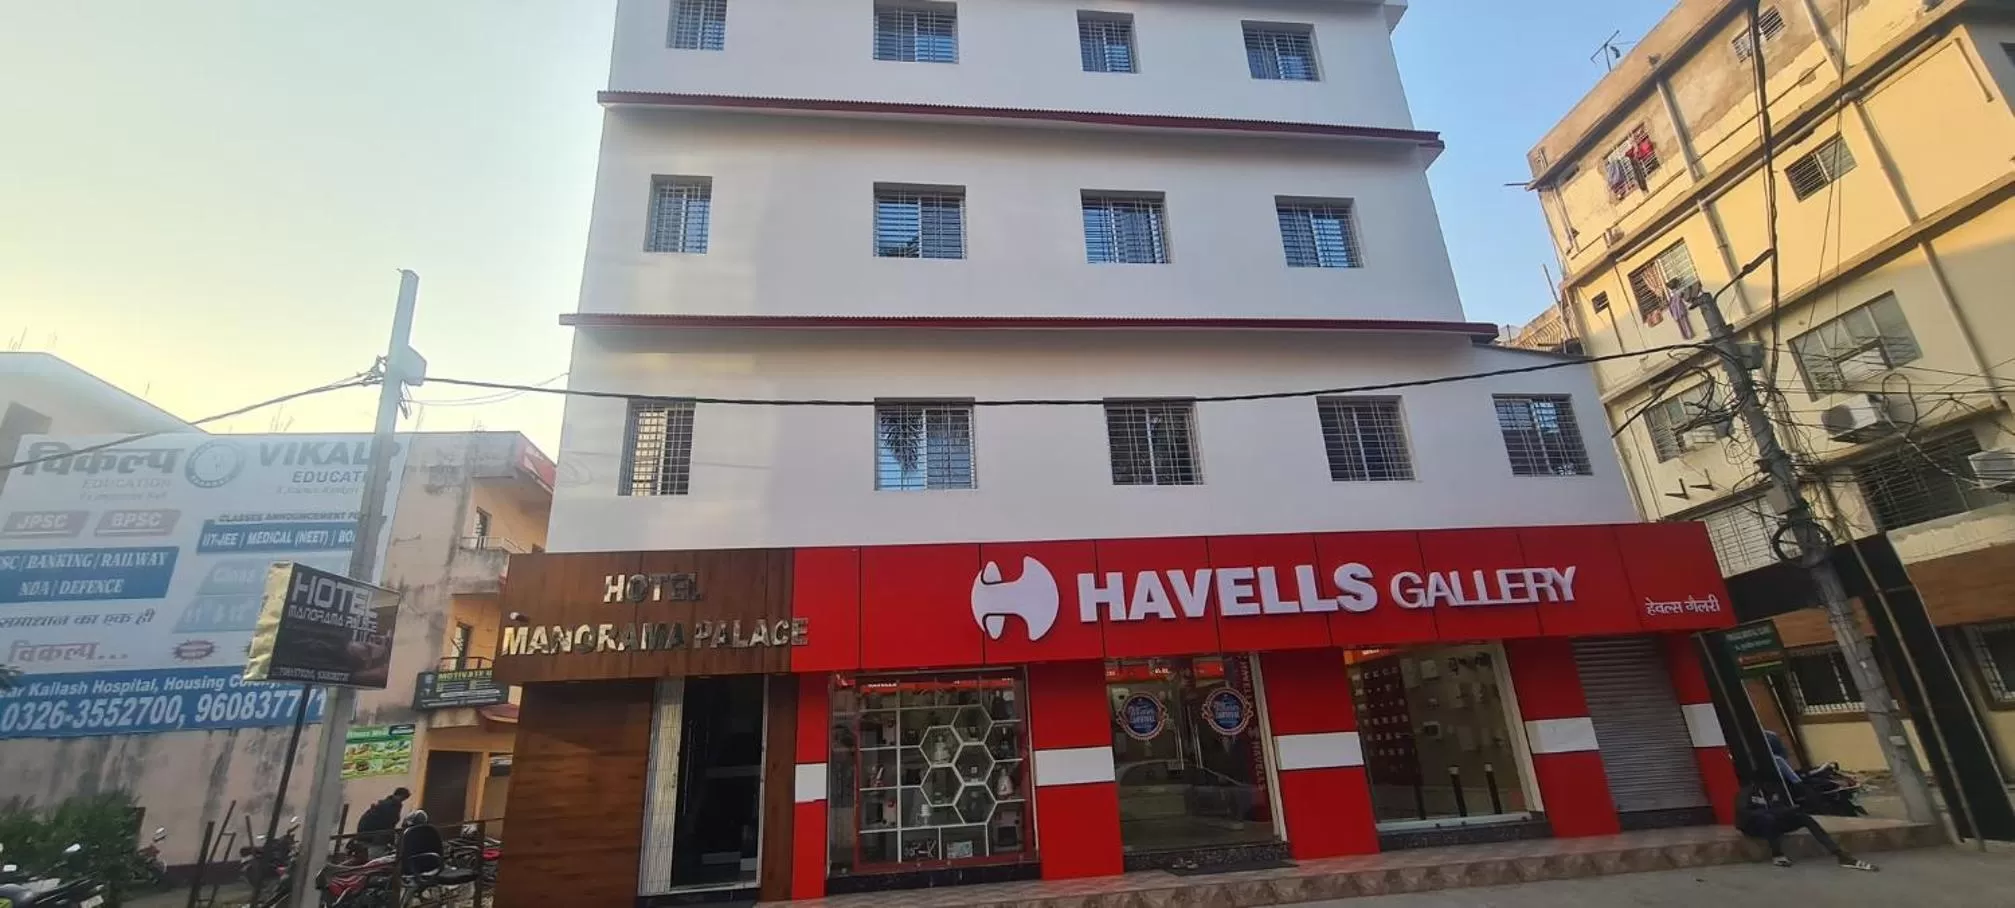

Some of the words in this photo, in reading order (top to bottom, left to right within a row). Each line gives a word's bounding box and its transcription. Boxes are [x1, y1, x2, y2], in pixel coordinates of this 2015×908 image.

[22, 441, 187, 476] विकल्प
[16, 513, 69, 530] JPSC
[111, 511, 163, 528] BPSC
[247, 531, 292, 545] MEDICAL
[100, 551, 168, 567] RAILWAY
[59, 578, 125, 595] DEFENCE
[291, 571, 378, 618] HOTEL
[603, 573, 702, 602] HOTEL
[1077, 563, 1378, 623] HAVELLS
[1390, 566, 1576, 609] GALLERY
[1645, 596, 1684, 616] हेवल्स
[1684, 594, 1720, 613] गैलरी
[73, 614, 101, 625] का
[502, 623, 685, 656] MANORAMA
[694, 616, 809, 649] PALACE
[92, 678, 159, 695] Hospital,
[164, 674, 226, 692] Housing
[0, 695, 186, 732] 0326-3552700,
